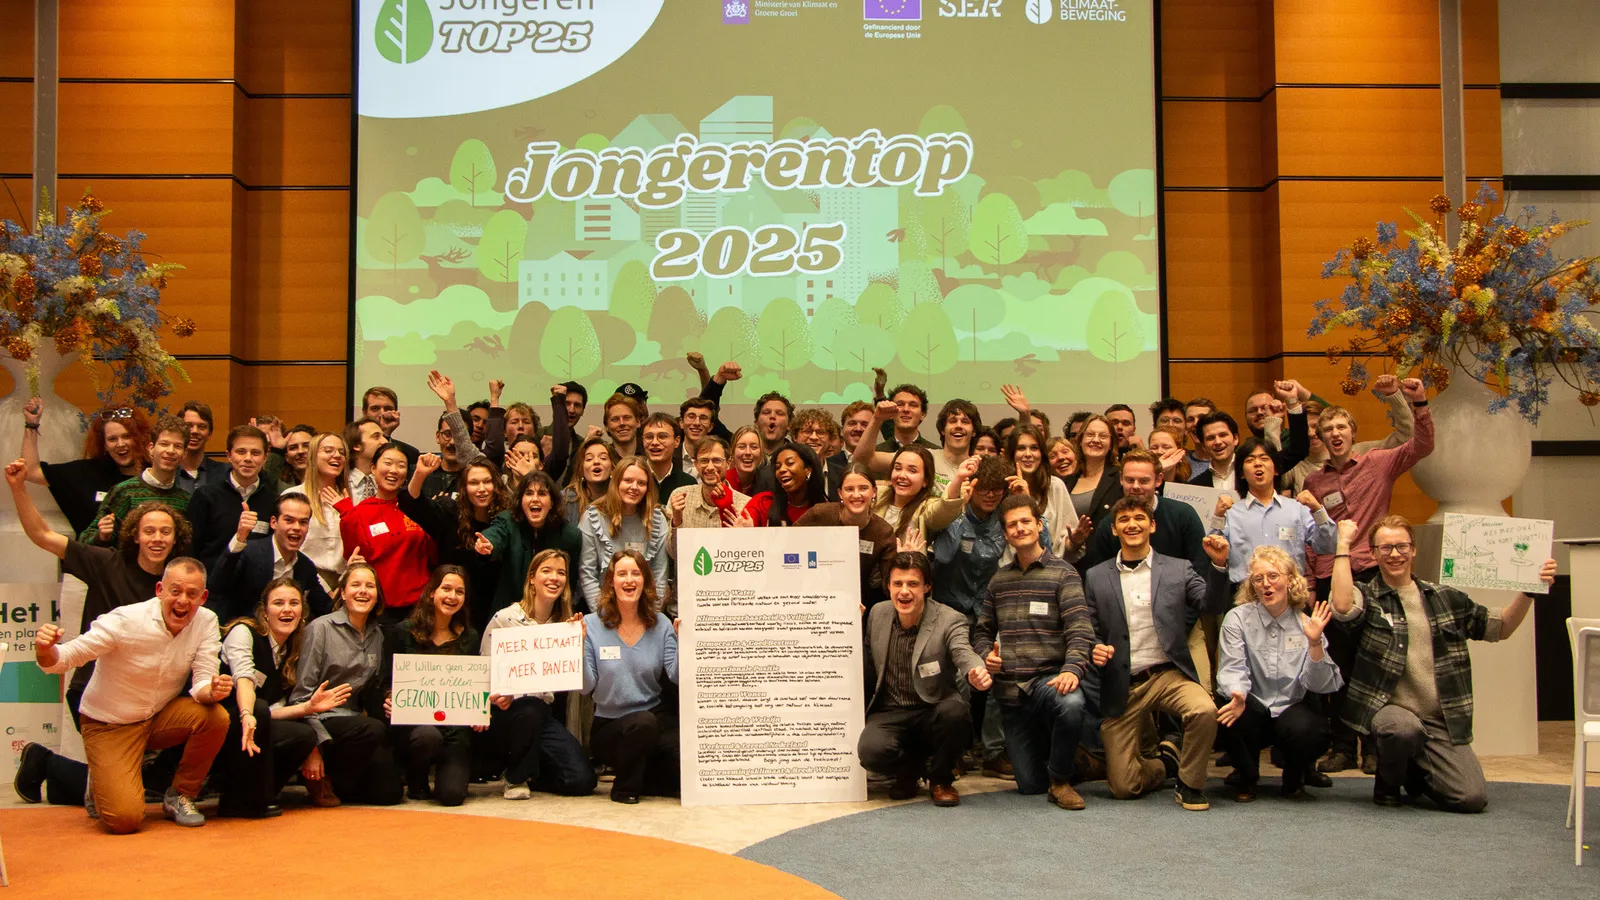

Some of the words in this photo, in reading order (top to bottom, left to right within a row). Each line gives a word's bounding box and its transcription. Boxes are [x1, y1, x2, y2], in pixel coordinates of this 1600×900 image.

[802, 1, 828, 9] Klimaat
[1060, 0, 1120, 9] KLIMAAT-
[755, 9, 778, 17] Groene
[1060, 9, 1126, 22] BEWEGING
[863, 23, 905, 31] Gefinancierd
[906, 23, 921, 31] door
[874, 31, 909, 40] Europese
[506, 129, 974, 209] Jongerentop
[649, 221, 846, 281] 2025
[714, 549, 765, 560] Jongeren
[714, 561, 765, 573] TOP'25
[14, 642, 26, 652] te
[496, 639, 528, 654] MEER
[533, 634, 582, 651] KLIMAAT!
[697, 640, 742, 648] Democratie
[748, 638, 769, 647] Goed
[446, 663, 464, 673] geen
[508, 663, 538, 678] MEER
[542, 658, 581, 677] BANEN!
[697, 665, 754, 674] Internationale
[753, 664, 781, 673] Positie
[395, 689, 441, 709] GEZOND
[444, 690, 491, 715] LEVEN!
[698, 716, 744, 725] Gezondheid
[751, 715, 782, 724] Welzijn
[699, 743, 736, 751] Werkend
[742, 742, 769, 750] Lerend
[768, 741, 808, 750] Nederland
[814, 765, 851, 774] Welvaart
